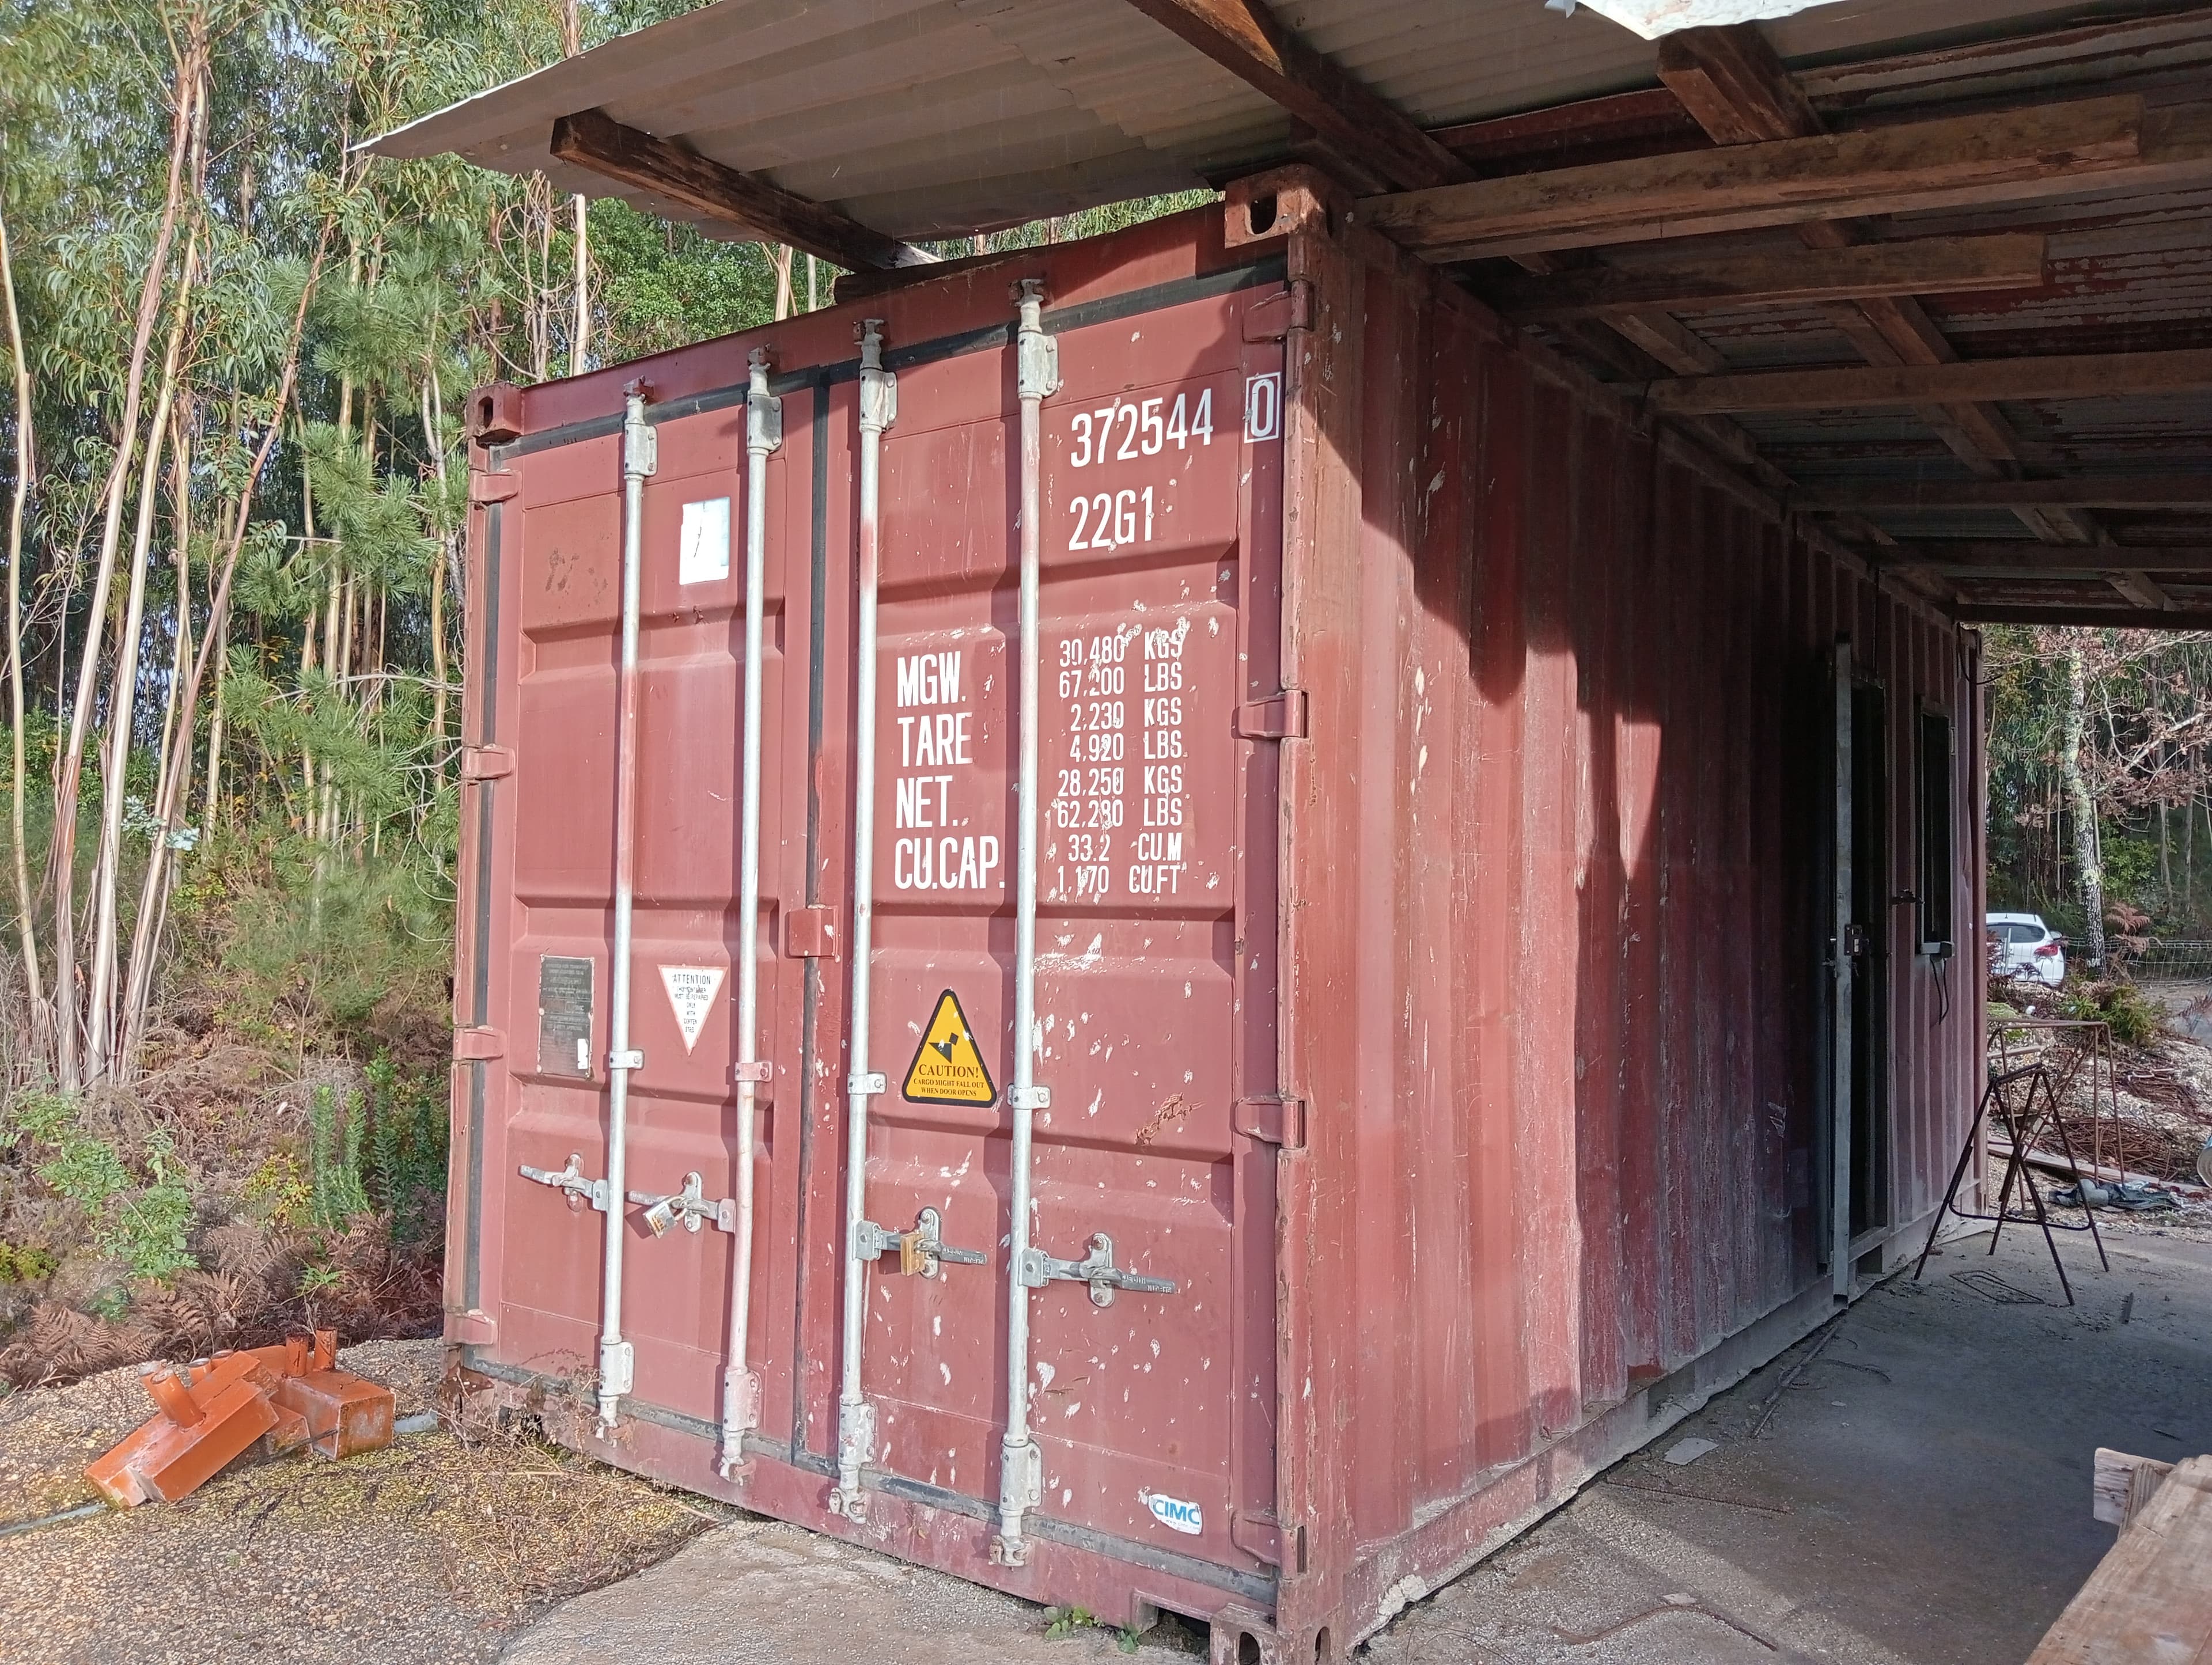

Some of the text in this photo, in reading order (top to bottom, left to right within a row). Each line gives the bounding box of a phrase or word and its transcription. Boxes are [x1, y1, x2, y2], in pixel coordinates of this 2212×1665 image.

[1070, 377, 1276, 468] 372544 0
[1068, 486, 1153, 551] 22G1
[1059, 629, 1183, 667] 30,480 KGS
[896, 650, 967, 708] MGW.
[1059, 661, 1183, 699] 67,200 LBS
[1070, 696, 1183, 732] 2,230 KGS
[896, 711, 974, 768] TARE
[1070, 730, 1183, 763] 4,920 LBS
[1058, 764, 1183, 797] 28,250 KGS
[895, 775, 959, 829] NET.
[1057, 797, 1183, 828] 62,280 LBS
[894, 835, 1006, 890] CU.CAP.
[1068, 832, 1183, 862] 33.2 CU.M
[1057, 864, 1181, 894] 1,170 CU.FT
[673, 973, 711, 985] ATTENTION
[918, 1064, 979, 1079] CAUTION!
[935, 1079, 955, 1087] MIGHT
[1153, 1499, 1200, 1526] CIMC
